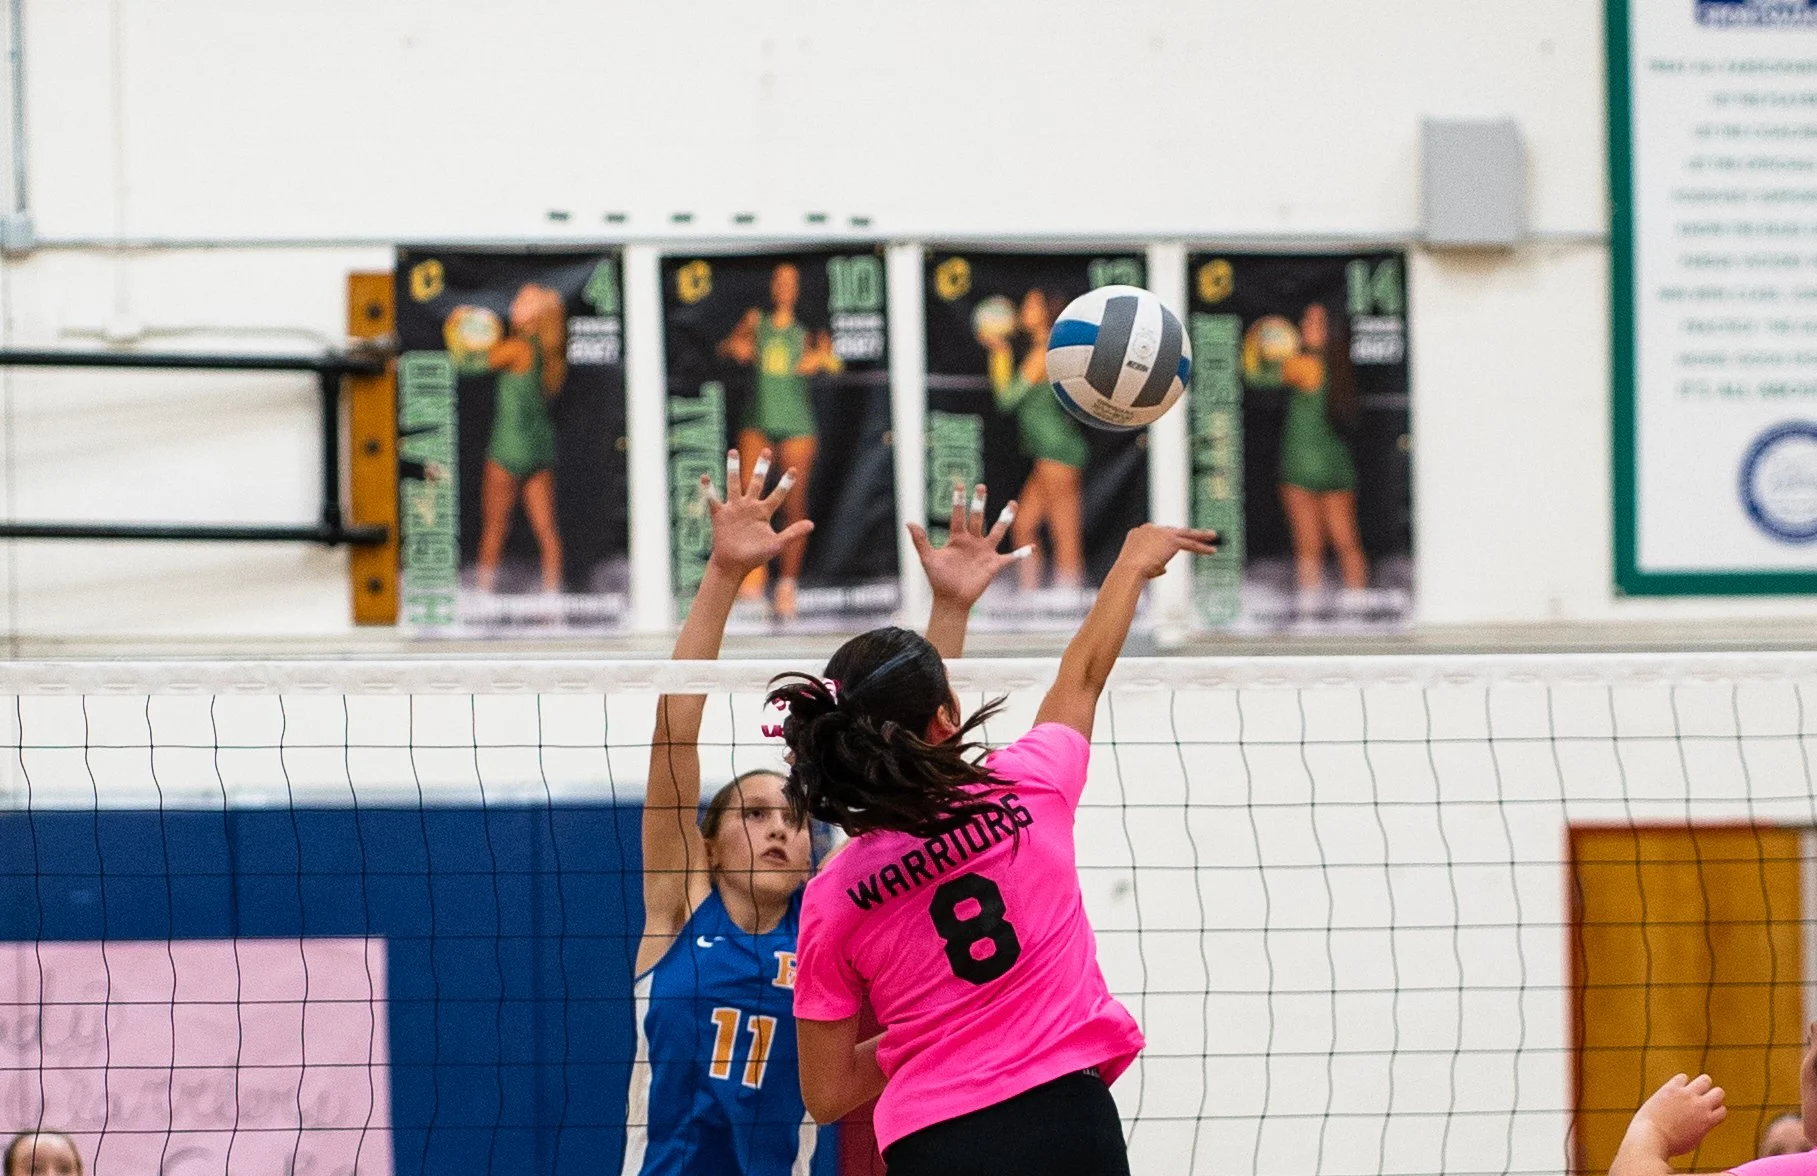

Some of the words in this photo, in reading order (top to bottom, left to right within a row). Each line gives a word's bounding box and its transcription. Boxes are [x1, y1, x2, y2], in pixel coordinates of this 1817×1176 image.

[828, 256, 882, 312] 10
[1346, 260, 1402, 313] 14
[846, 793, 1034, 911] WARRIORS
[928, 871, 1022, 986] 8
[709, 1007, 777, 1089] 11
